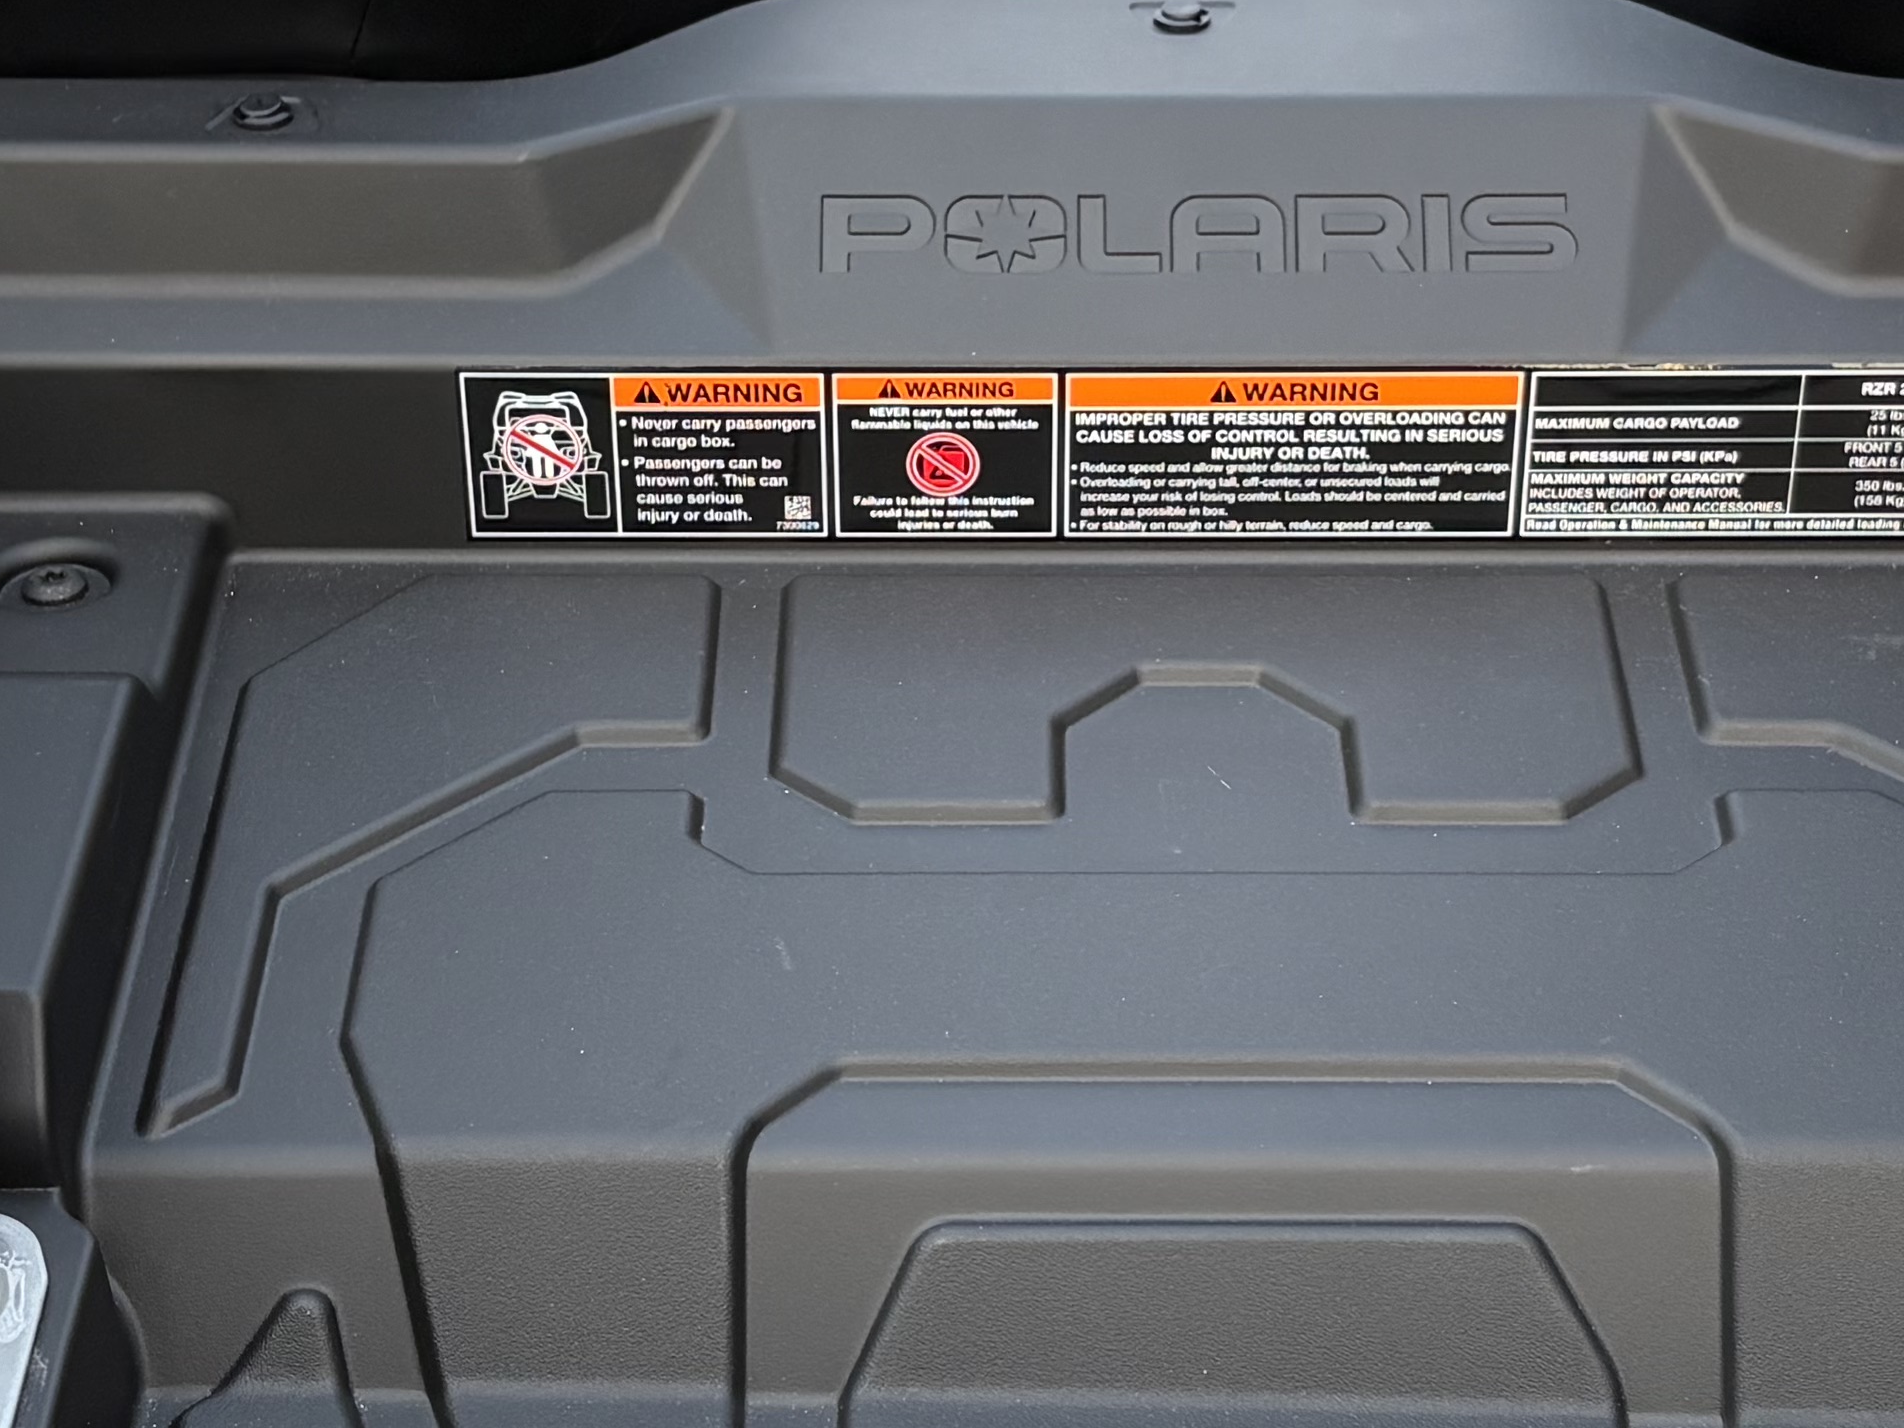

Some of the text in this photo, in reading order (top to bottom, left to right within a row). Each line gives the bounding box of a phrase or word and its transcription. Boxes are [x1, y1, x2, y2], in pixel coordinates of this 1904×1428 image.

[818, 192, 1578, 274] POLARIS
[667, 382, 803, 403] WARNING
[904, 381, 1015, 398] WARNING
[1242, 382, 1379, 402] WARNING
[1861, 382, 1896, 396] RZR
[869, 407, 1017, 419] NEVER carry fuel or other
[1075, 412, 1506, 425] IMPROPER TIRE PRESSURE OR OVERLOADING CAN
[1869, 410, 1887, 421] 25
[631, 417, 817, 432] Never carry passengers
[1534, 417, 1740, 429] MAXIMUM CARGO PAYLOAD
[633, 434, 735, 449] in cargo box.
[1075, 429, 1504, 443] CAUSE LOSS OF CONTROL RESULTING IN SERIOUS
[1211, 447, 1370, 460] INJURY OR DEATH.
[1844, 442, 1892, 453] FRONT
[1893, 442, 1903, 453] 5
[1533, 451, 1738, 463] TIRE PRESSURE IN PSI (KPa)
[1848, 457, 1887, 468] REAR
[1889, 457, 1898, 468] 5
[633, 456, 782, 472] Passengers can be
[1080, 462, 1510, 474] Reduce speed and allow greater distance for braking when carrying cargo.
[635, 474, 788, 487] thrown off. This can
[1080, 477, 1151, 489] Overloading
[1153, 478, 1166, 487] or
[1168, 477, 1216, 489] carrying
[1304, 478, 1317, 487] or
[1320, 477, 1382, 487] unsecured
[1384, 477, 1417, 487] loads
[1419, 477, 1440, 487] will
[1530, 473, 1745, 484] MAXIMUM WEIGHT CAPACITY
[1854, 480, 1880, 491] 350
[636, 491, 743, 504] cause serious
[1080, 491, 1506, 504] increase your risk of losing control. Loads should be centered and carried
[1529, 487, 1593, 498] INCLUDES
[1596, 487, 1645, 498] WEIGHT
[1648, 487, 1668, 498] OF
[1080, 506, 1228, 518] as low as possible in box.
[1662, 502, 1691, 513] AND
[1693, 502, 1786, 513] ACCESSORIES.
[637, 508, 752, 524] injury or death.
[1080, 520, 1100, 531] For
[1102, 520, 1146, 533] stability
[1149, 521, 1165, 531] on
[1167, 520, 1202, 533] rough
[1204, 521, 1216, 531] or
[1218, 520, 1243, 533] hilly
[1288, 520, 1330, 531] reduce
[1332, 520, 1369, 533] speed
[1371, 520, 1395, 531] and
[1396, 521, 1434, 533] cargo.
